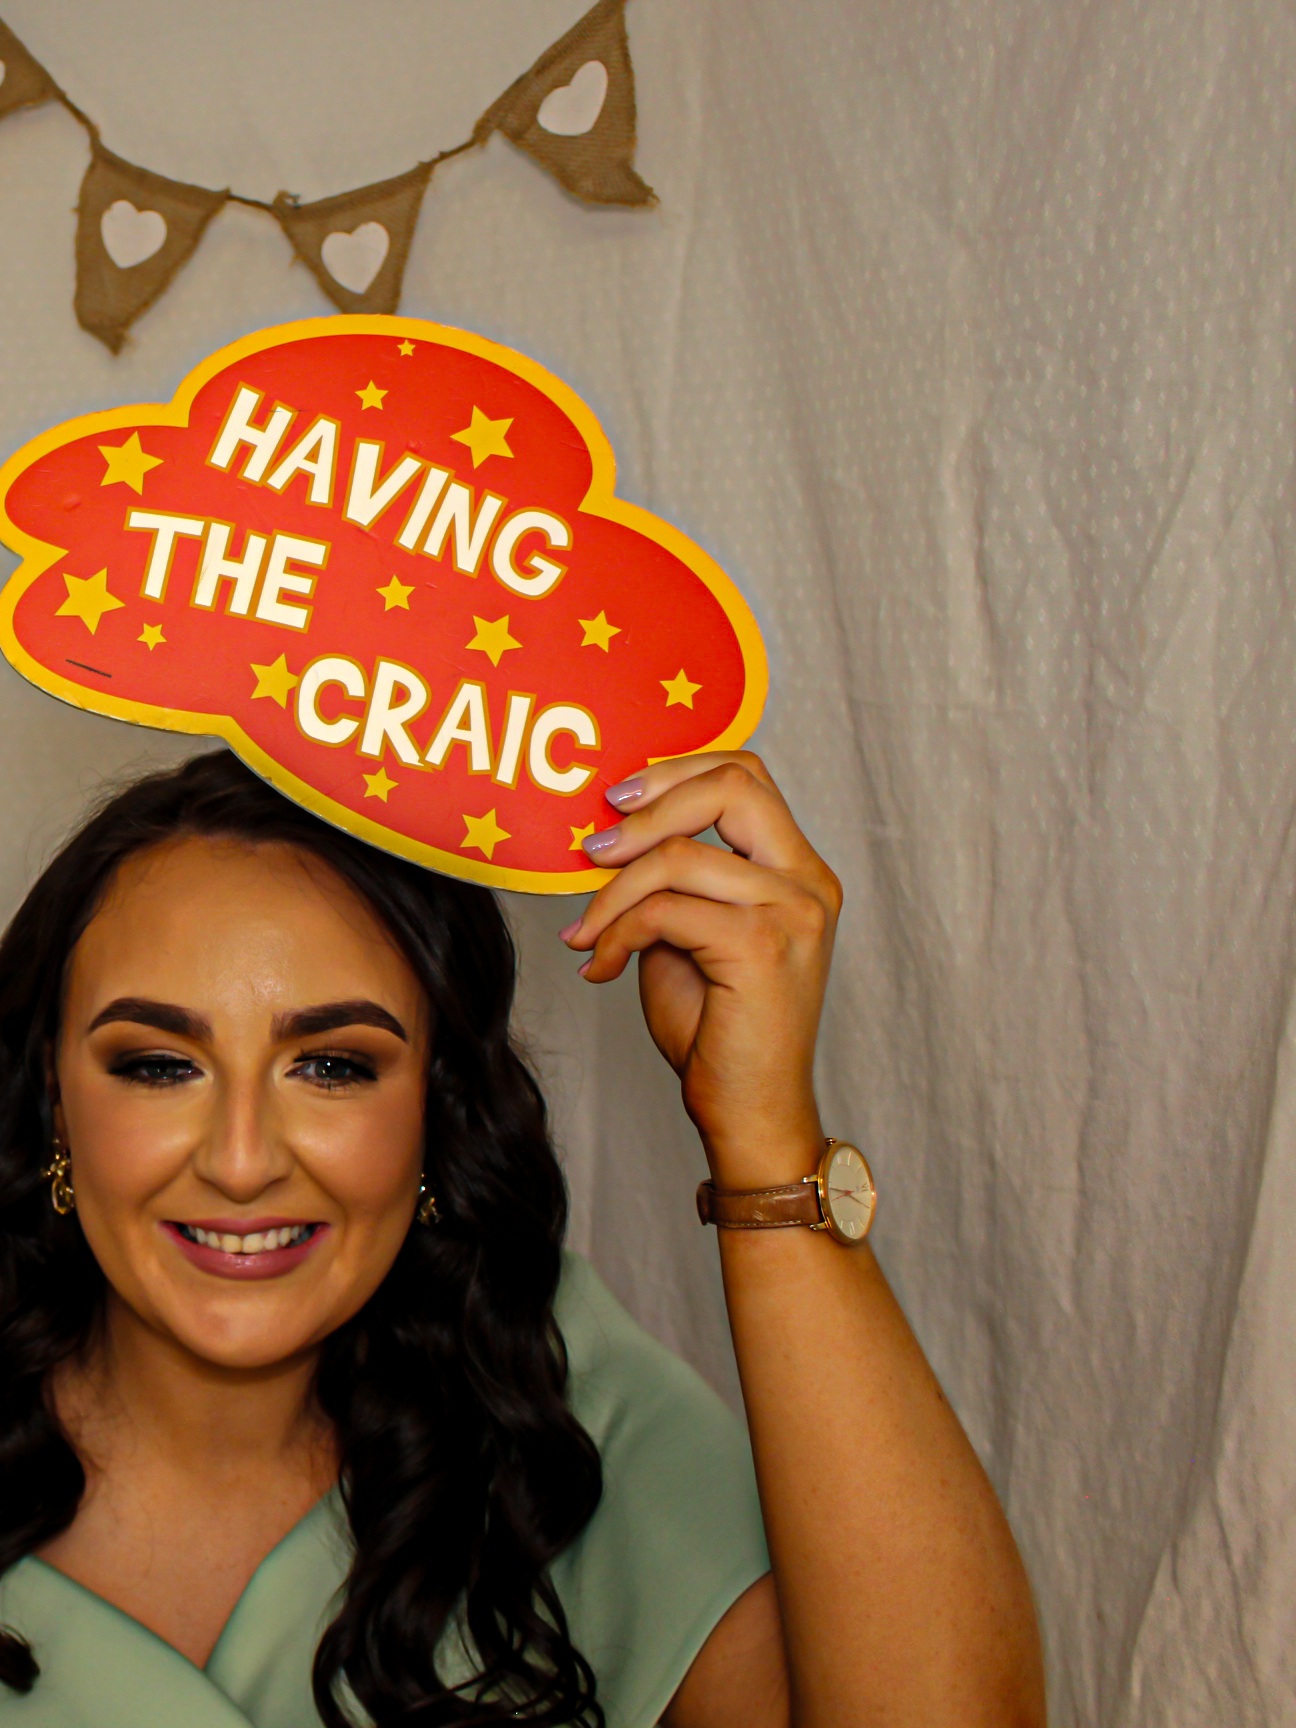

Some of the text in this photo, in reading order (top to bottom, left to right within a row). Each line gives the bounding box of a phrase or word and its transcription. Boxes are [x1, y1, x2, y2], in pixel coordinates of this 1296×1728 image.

[206, 385, 571, 599] HAVING
[126, 509, 329, 631] THE
[294, 656, 599, 795] CRAIC
